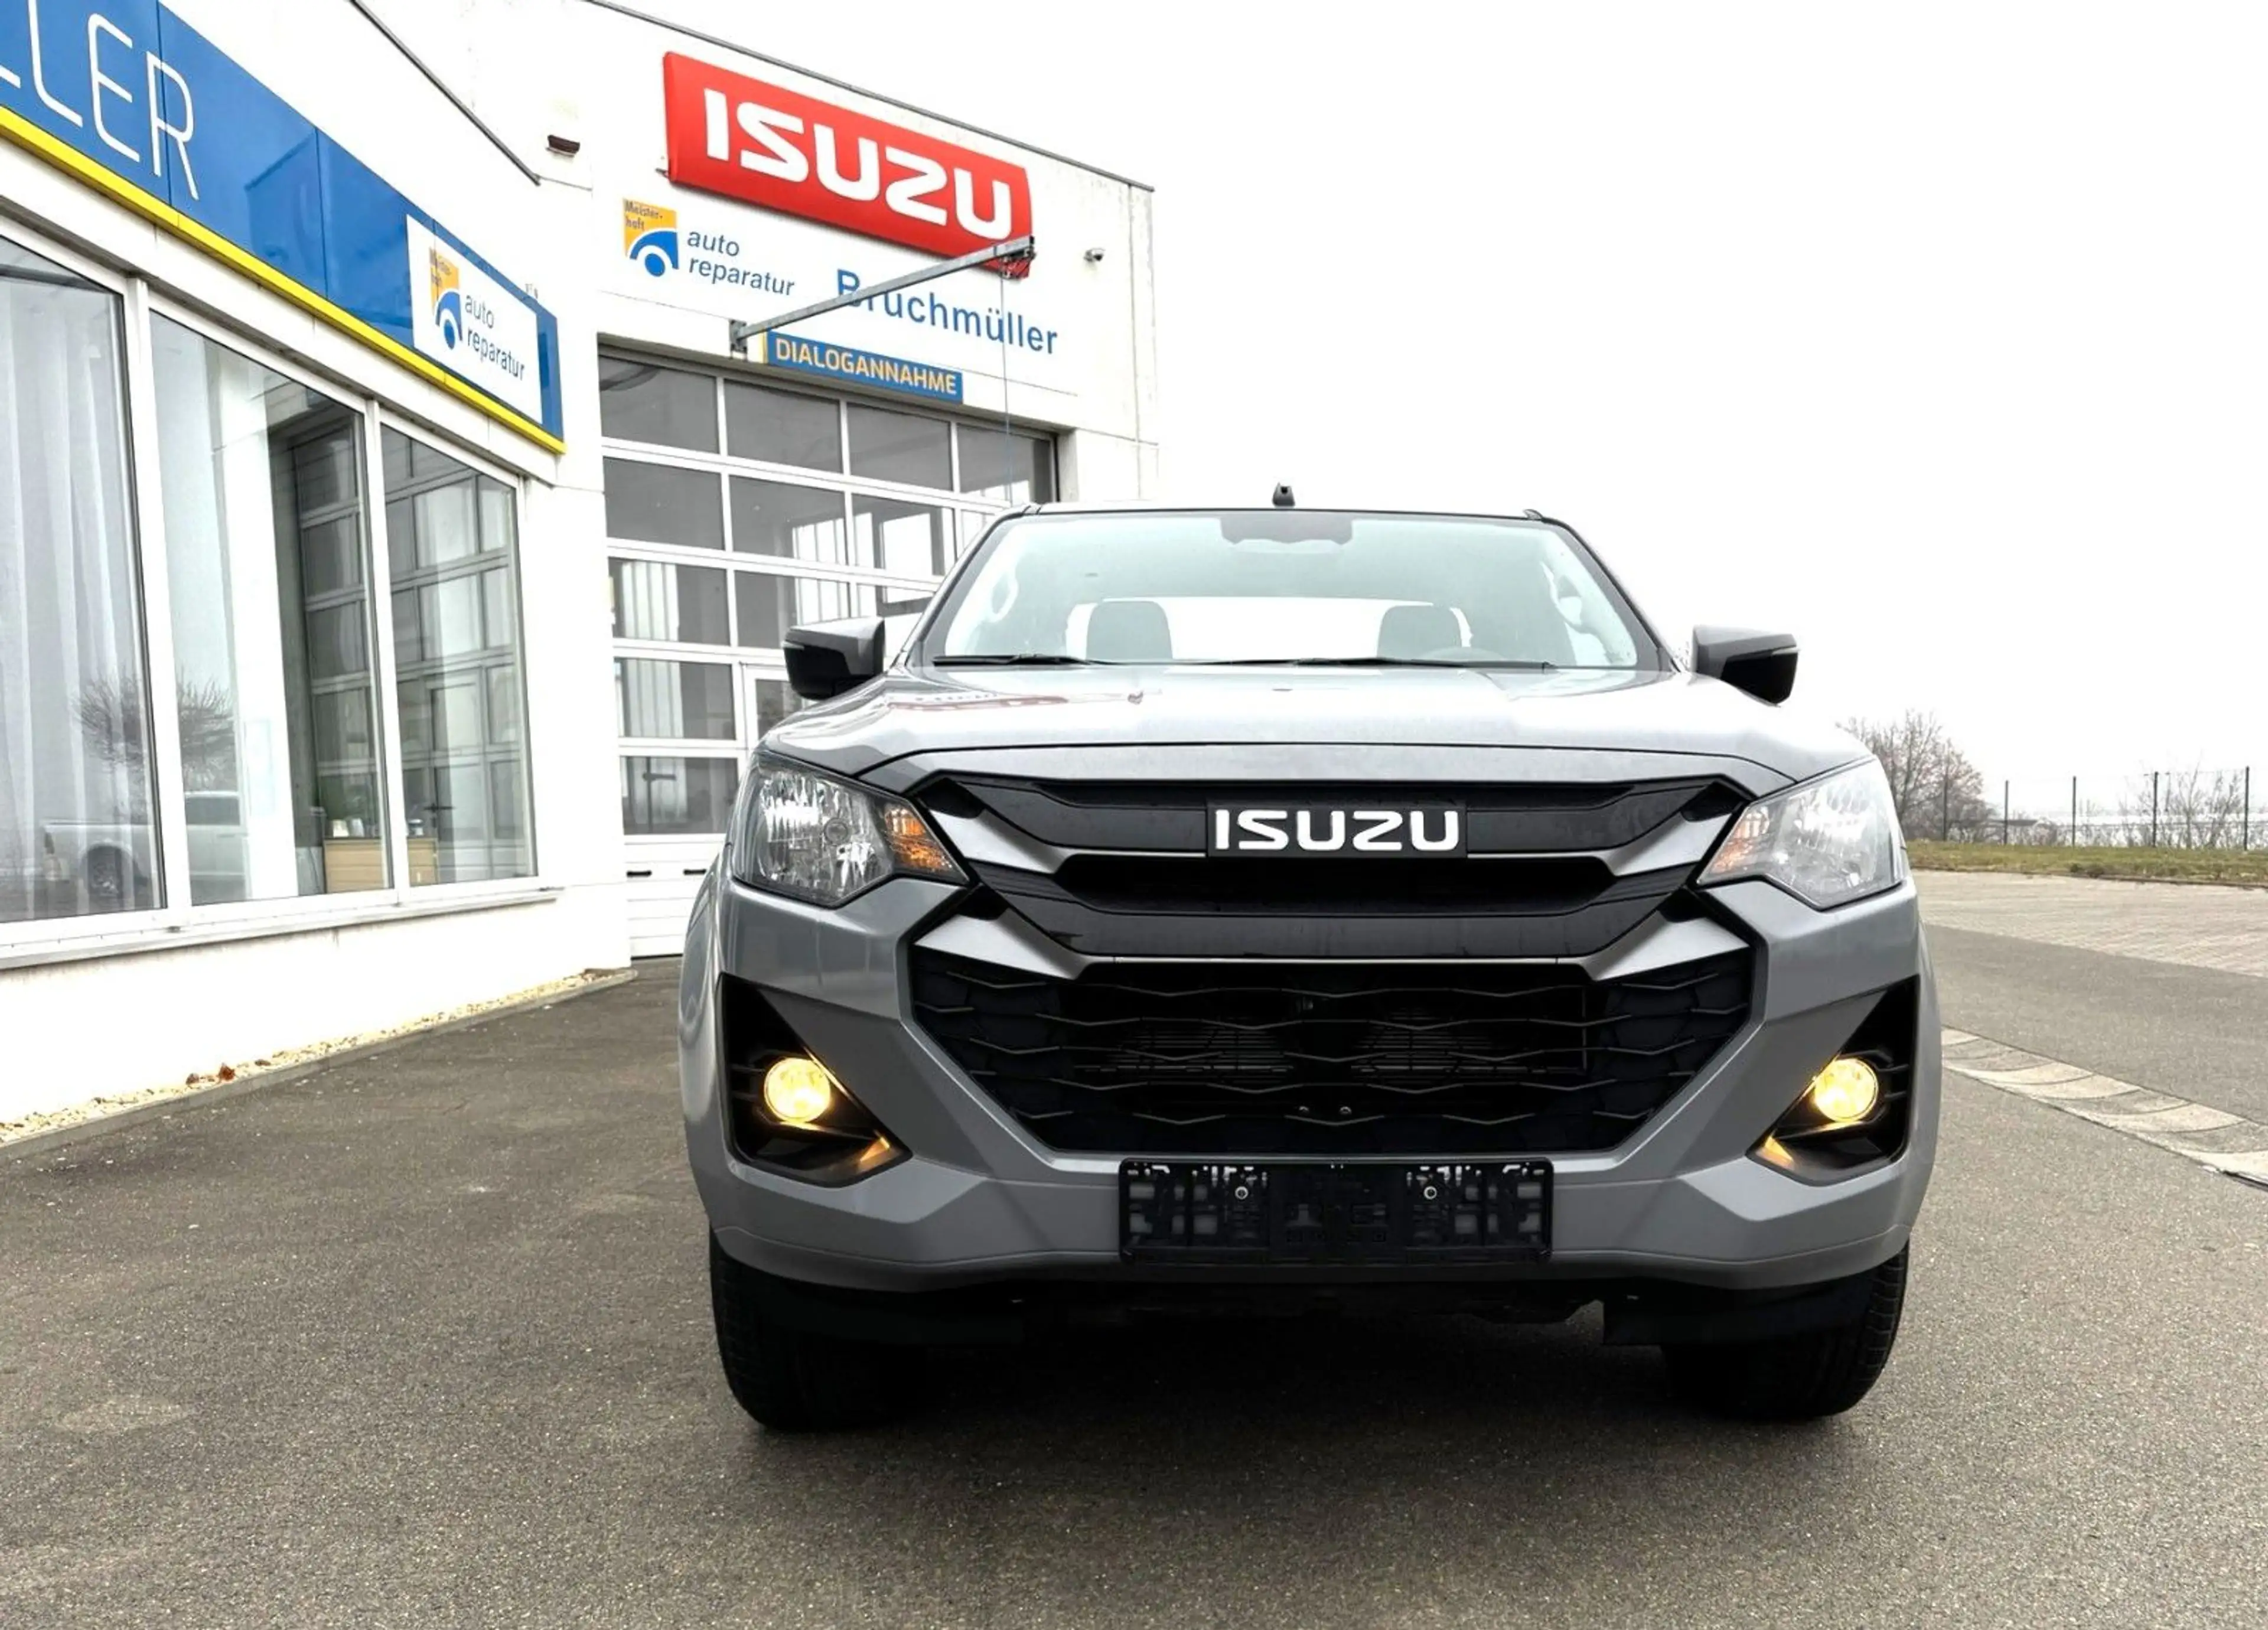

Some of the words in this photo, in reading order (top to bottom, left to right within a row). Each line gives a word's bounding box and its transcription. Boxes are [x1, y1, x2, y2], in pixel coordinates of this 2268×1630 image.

[0, 0, 199, 201] LER
[704, 88, 1011, 240] ISUZU
[687, 231, 739, 257] auto
[689, 257, 795, 296] reparatur
[465, 295, 494, 329] auto
[467, 326, 525, 381] reparatur
[775, 337, 957, 395] DIALOGANNAHME
[1215, 809, 1459, 851] ISUZU
